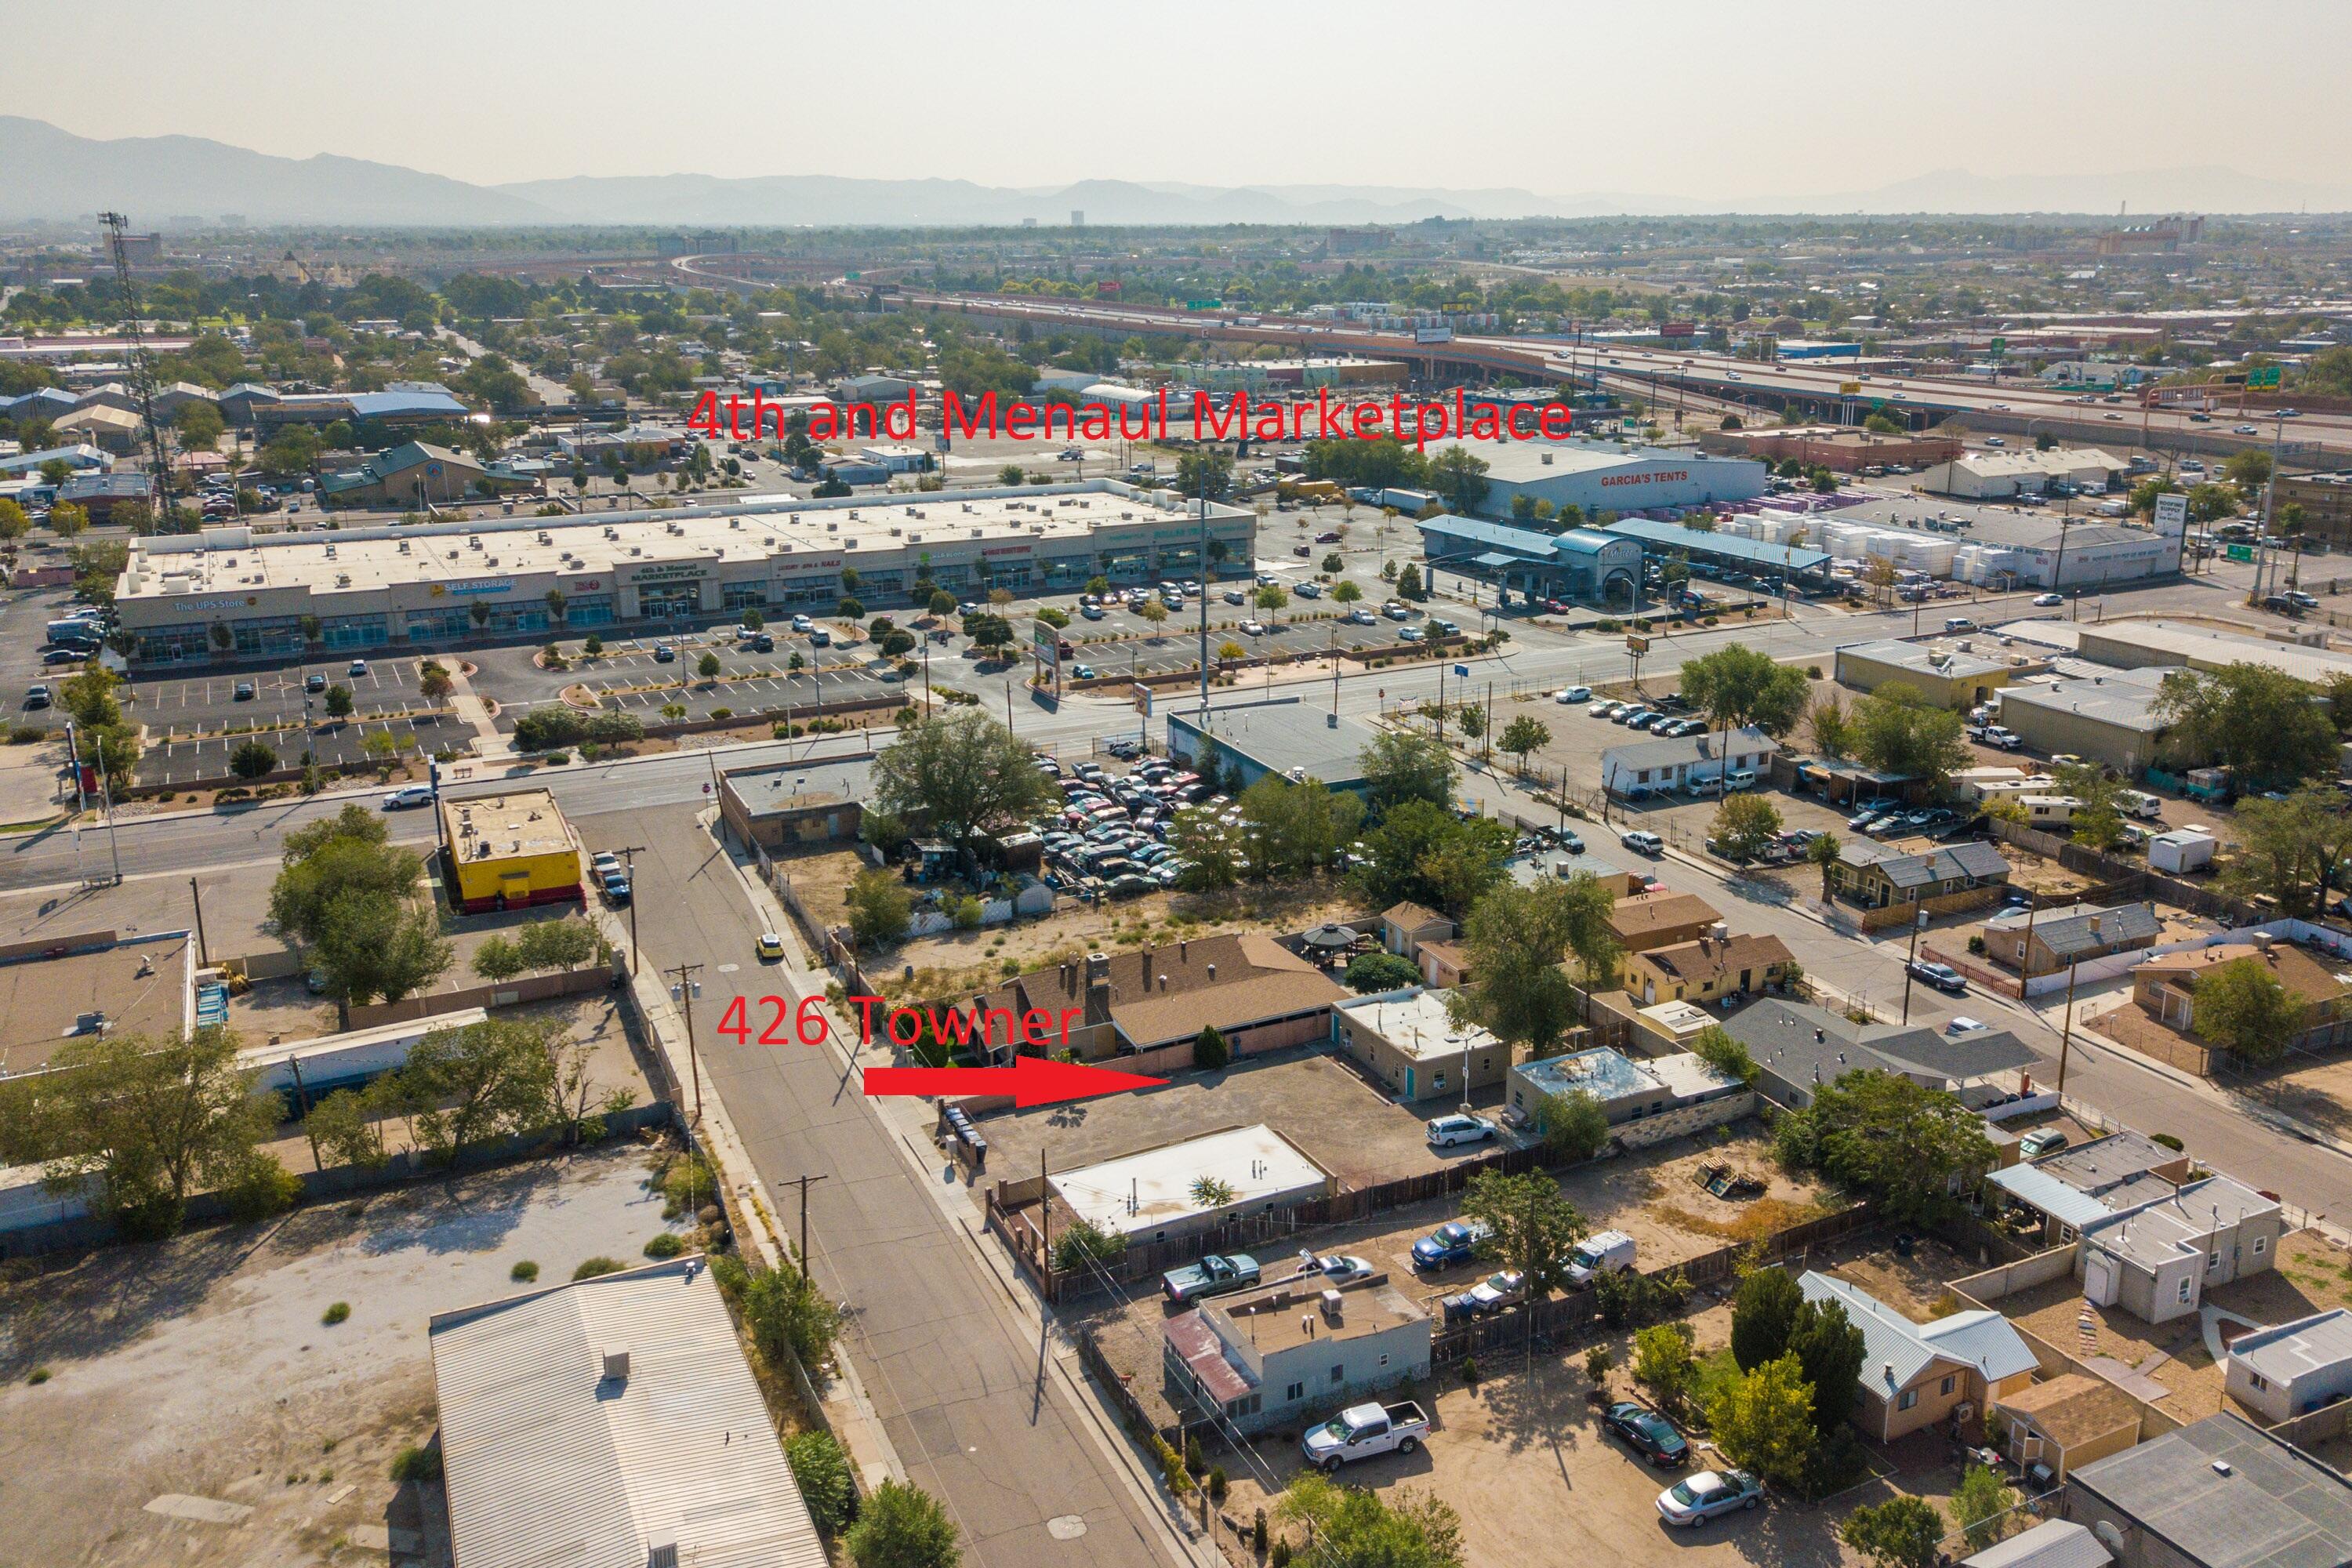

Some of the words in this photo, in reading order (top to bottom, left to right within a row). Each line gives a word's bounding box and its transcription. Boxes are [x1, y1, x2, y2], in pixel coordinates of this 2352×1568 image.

[1601, 474, 1650, 486] GARCIA'S
[1653, 470, 1688, 482] TENTS
[1609, 549, 1632, 558] Mister
[631, 570, 708, 582] MARKETPLACE
[445, 583, 469, 591] SELF
[472, 579, 517, 590] STORAGE
[174, 602, 194, 612] The
[196, 600, 216, 610] UPS
[220, 598, 245, 608] Store
